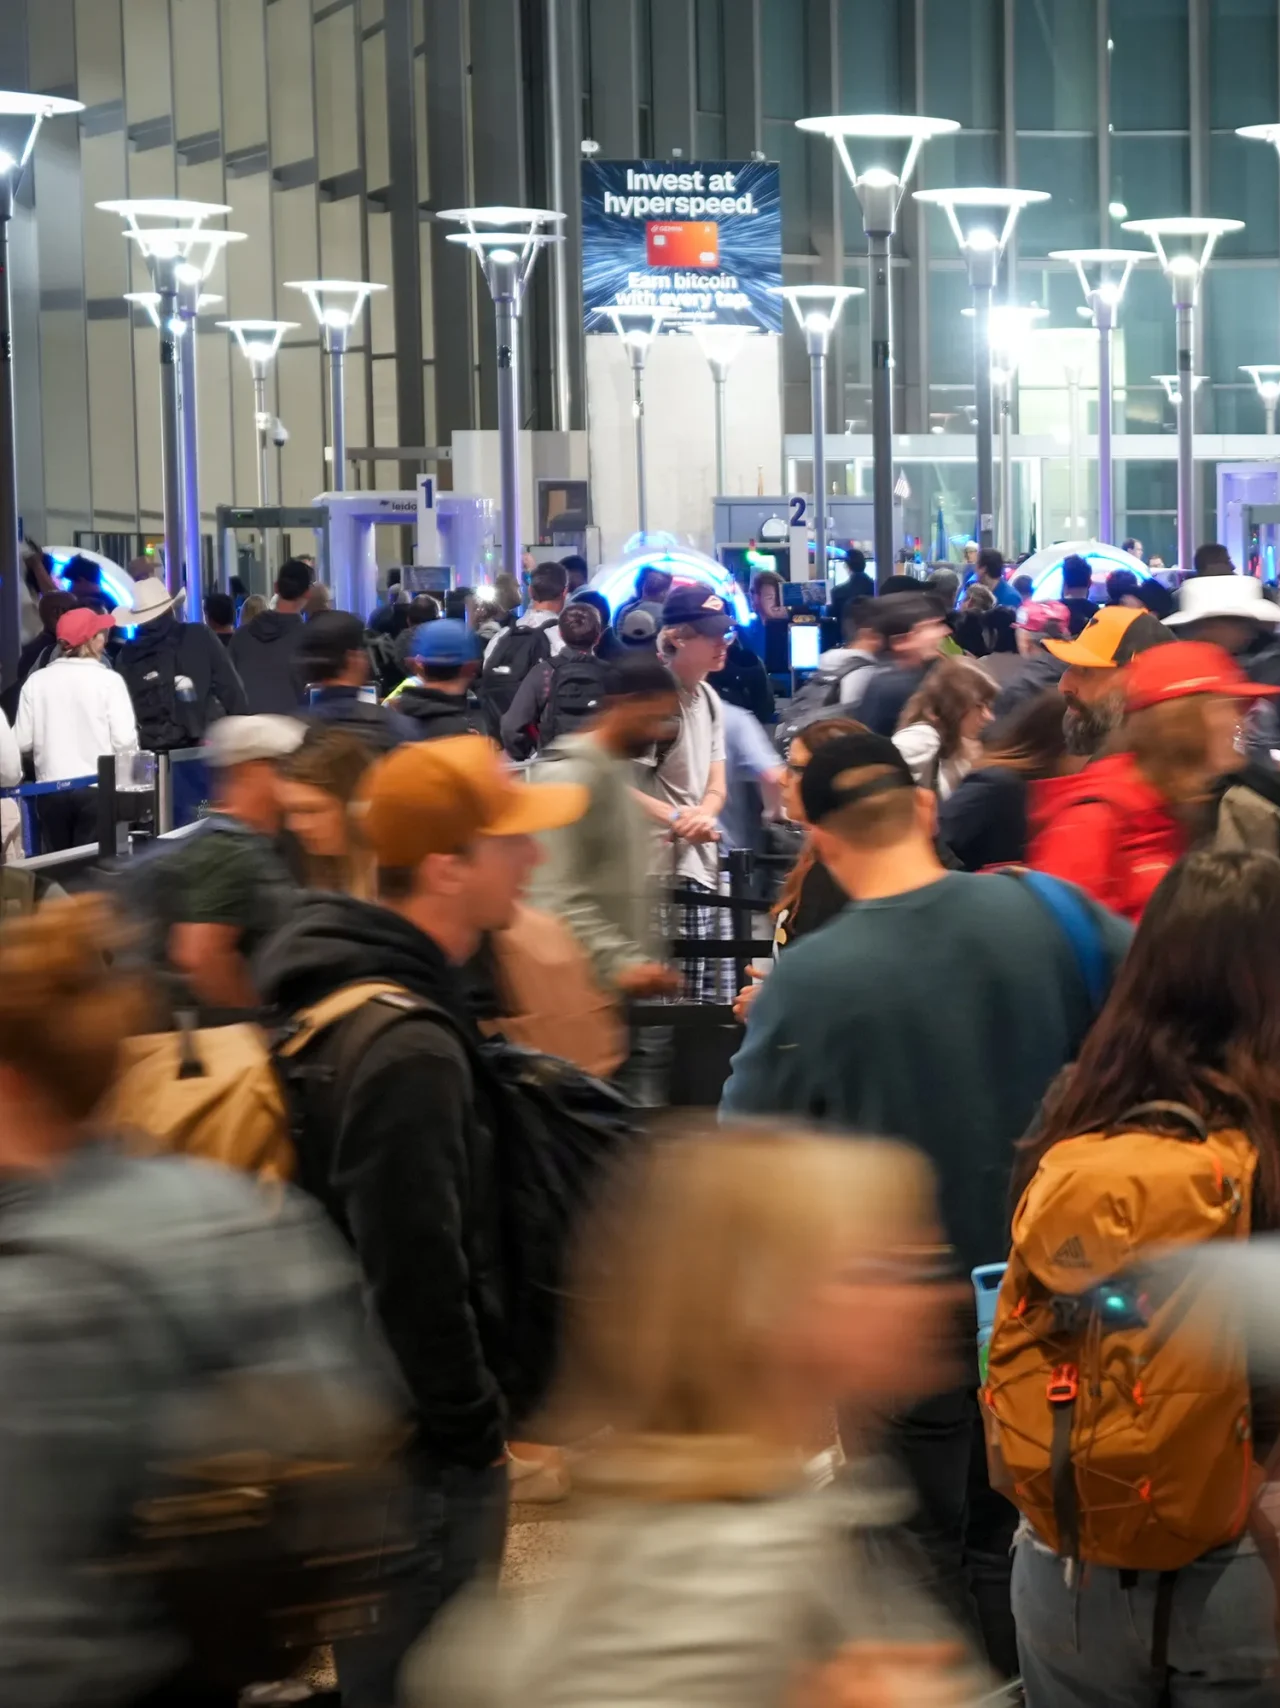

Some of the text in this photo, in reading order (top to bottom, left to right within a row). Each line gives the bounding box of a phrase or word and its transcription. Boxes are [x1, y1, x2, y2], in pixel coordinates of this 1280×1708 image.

[626, 168, 736, 191] Invest at
[604, 192, 759, 217] hyperspeed.
[628, 272, 737, 289] Earn bitcoin
[616, 290, 752, 309] with every tap.
[420, 478, 433, 508] 1
[392, 501, 418, 511] leido
[789, 497, 806, 527] 2
